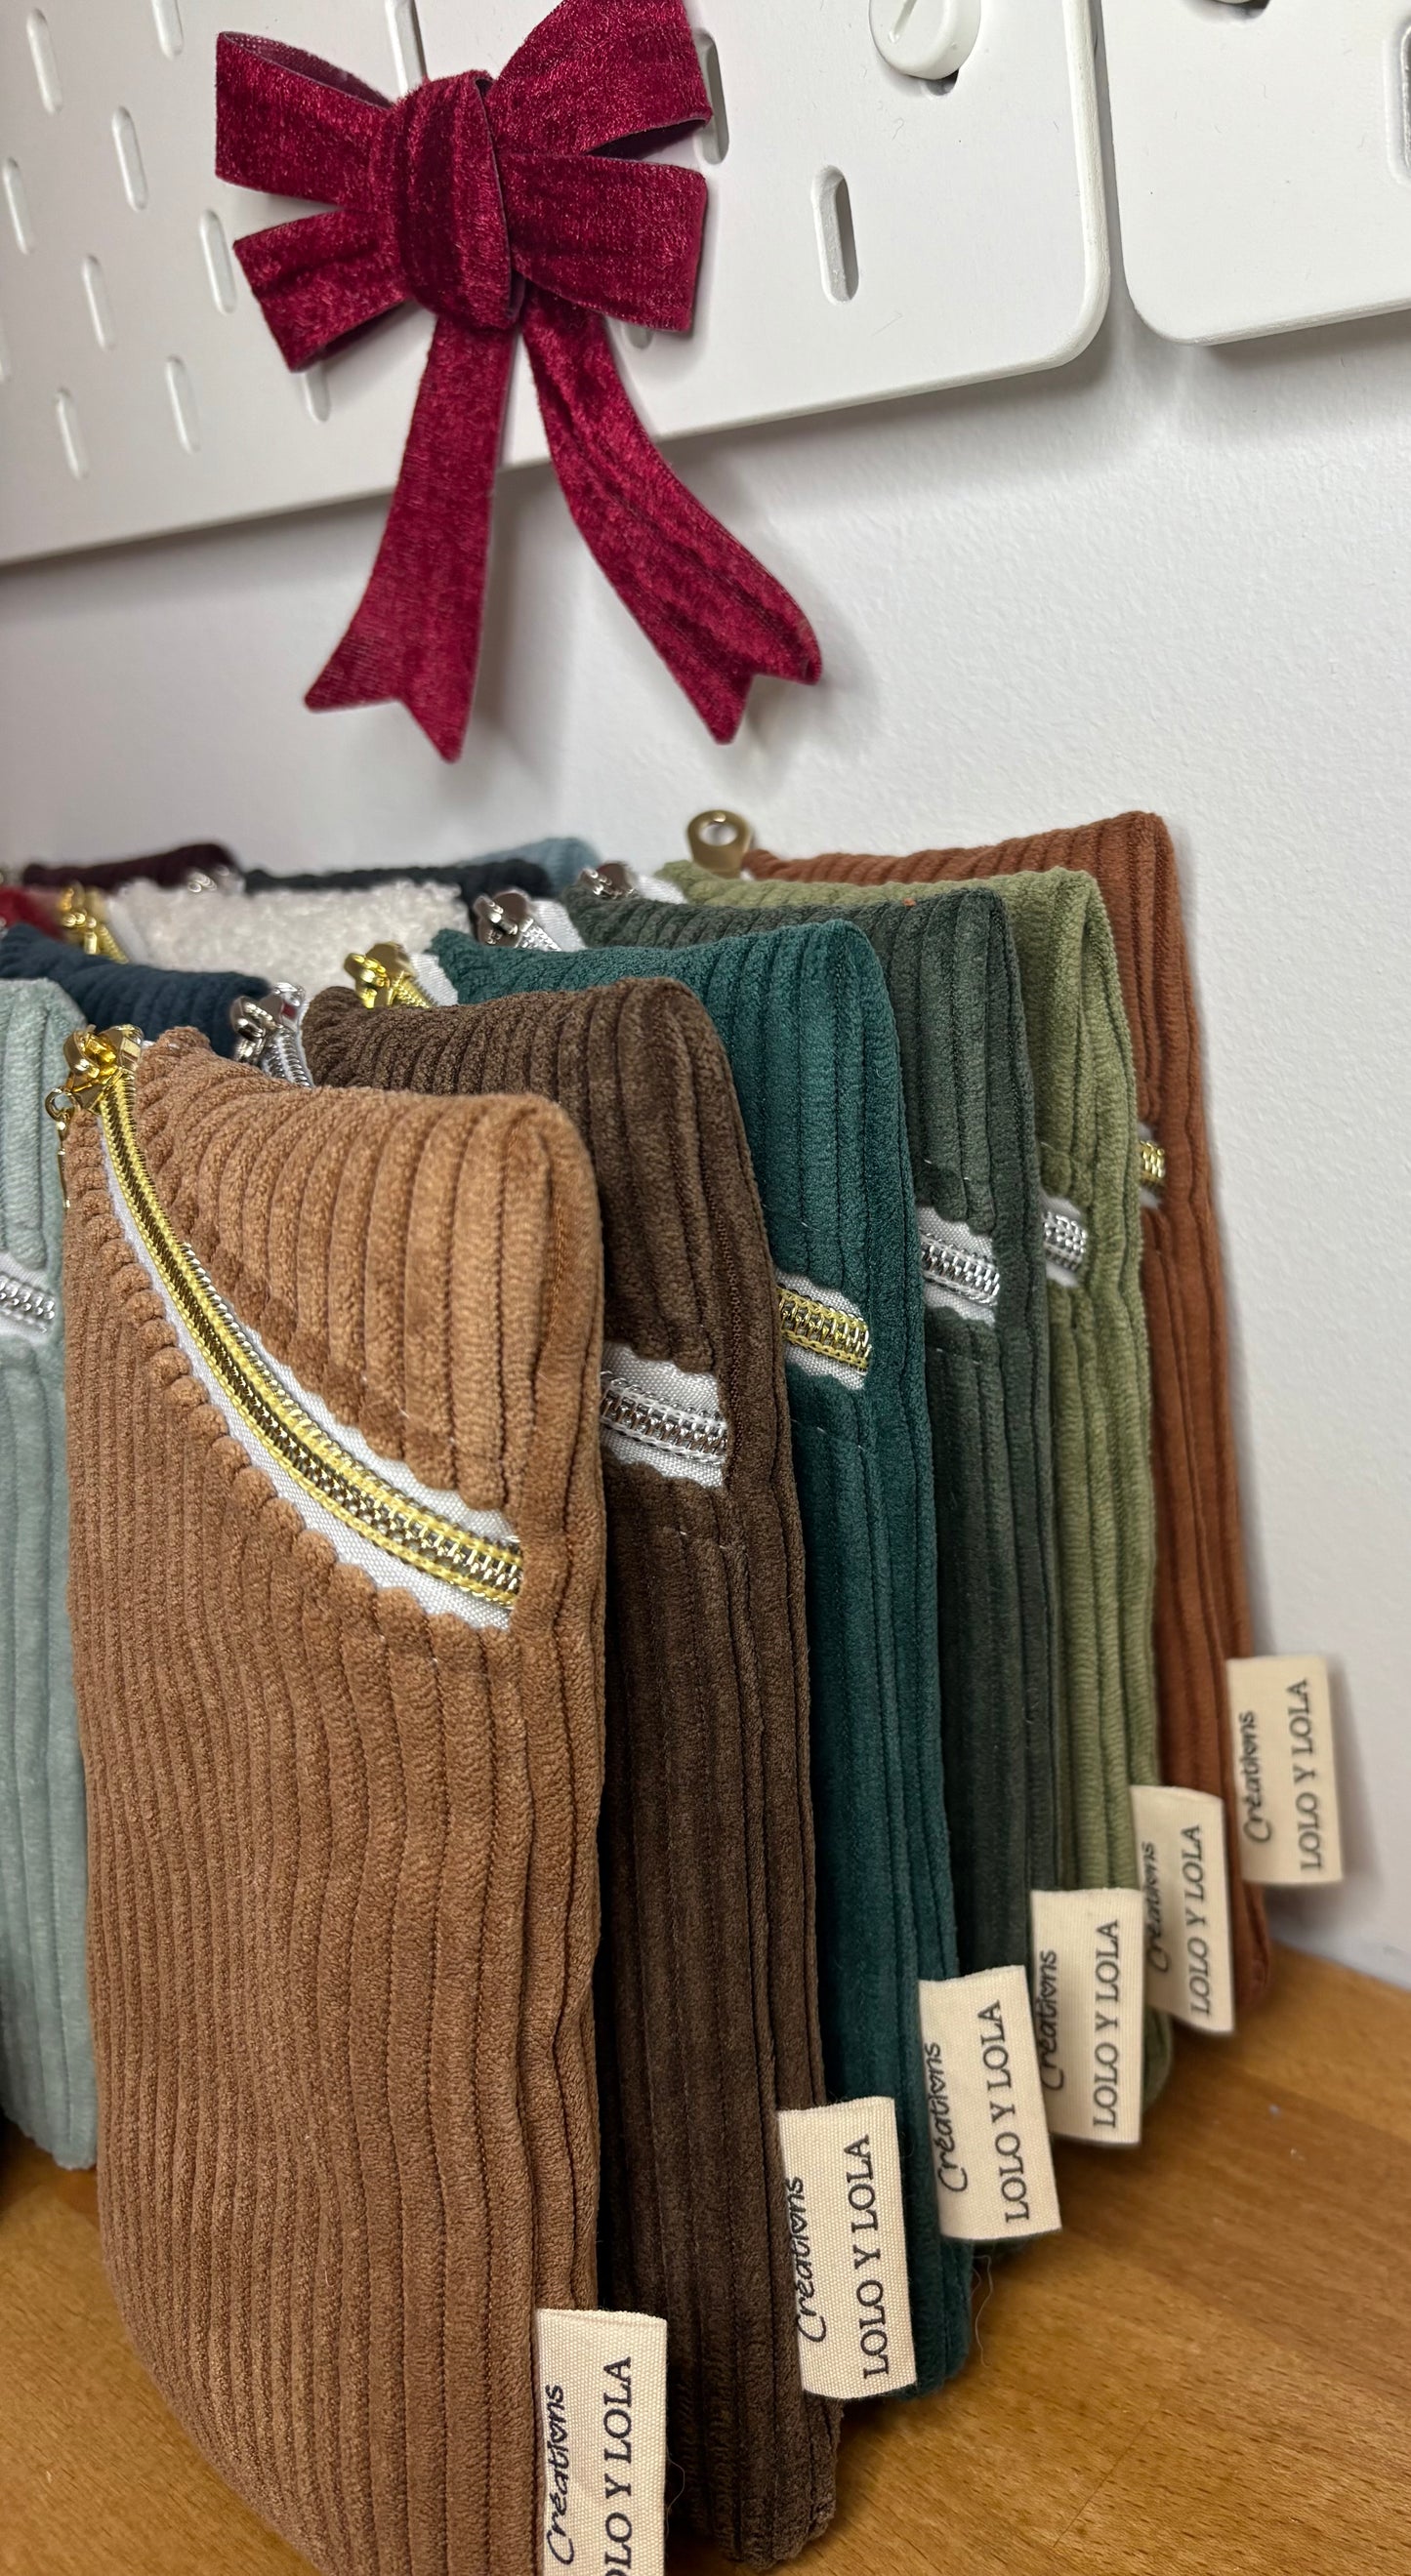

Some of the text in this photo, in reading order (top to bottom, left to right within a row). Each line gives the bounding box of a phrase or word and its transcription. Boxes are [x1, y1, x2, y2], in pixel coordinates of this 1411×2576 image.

[1286, 1678, 1322, 1870] LOLO Y LOLA
[1093, 1919, 1119, 2129] LOLO Y LOLA
[1181, 1824, 1211, 2017] LOLO Y LOLA
[977, 2000, 1030, 2224] LOLO Y LOLA
[844, 2134, 890, 2380] LOLO Y LOLA
[603, 2356, 633, 2576] LO Y LOLA
